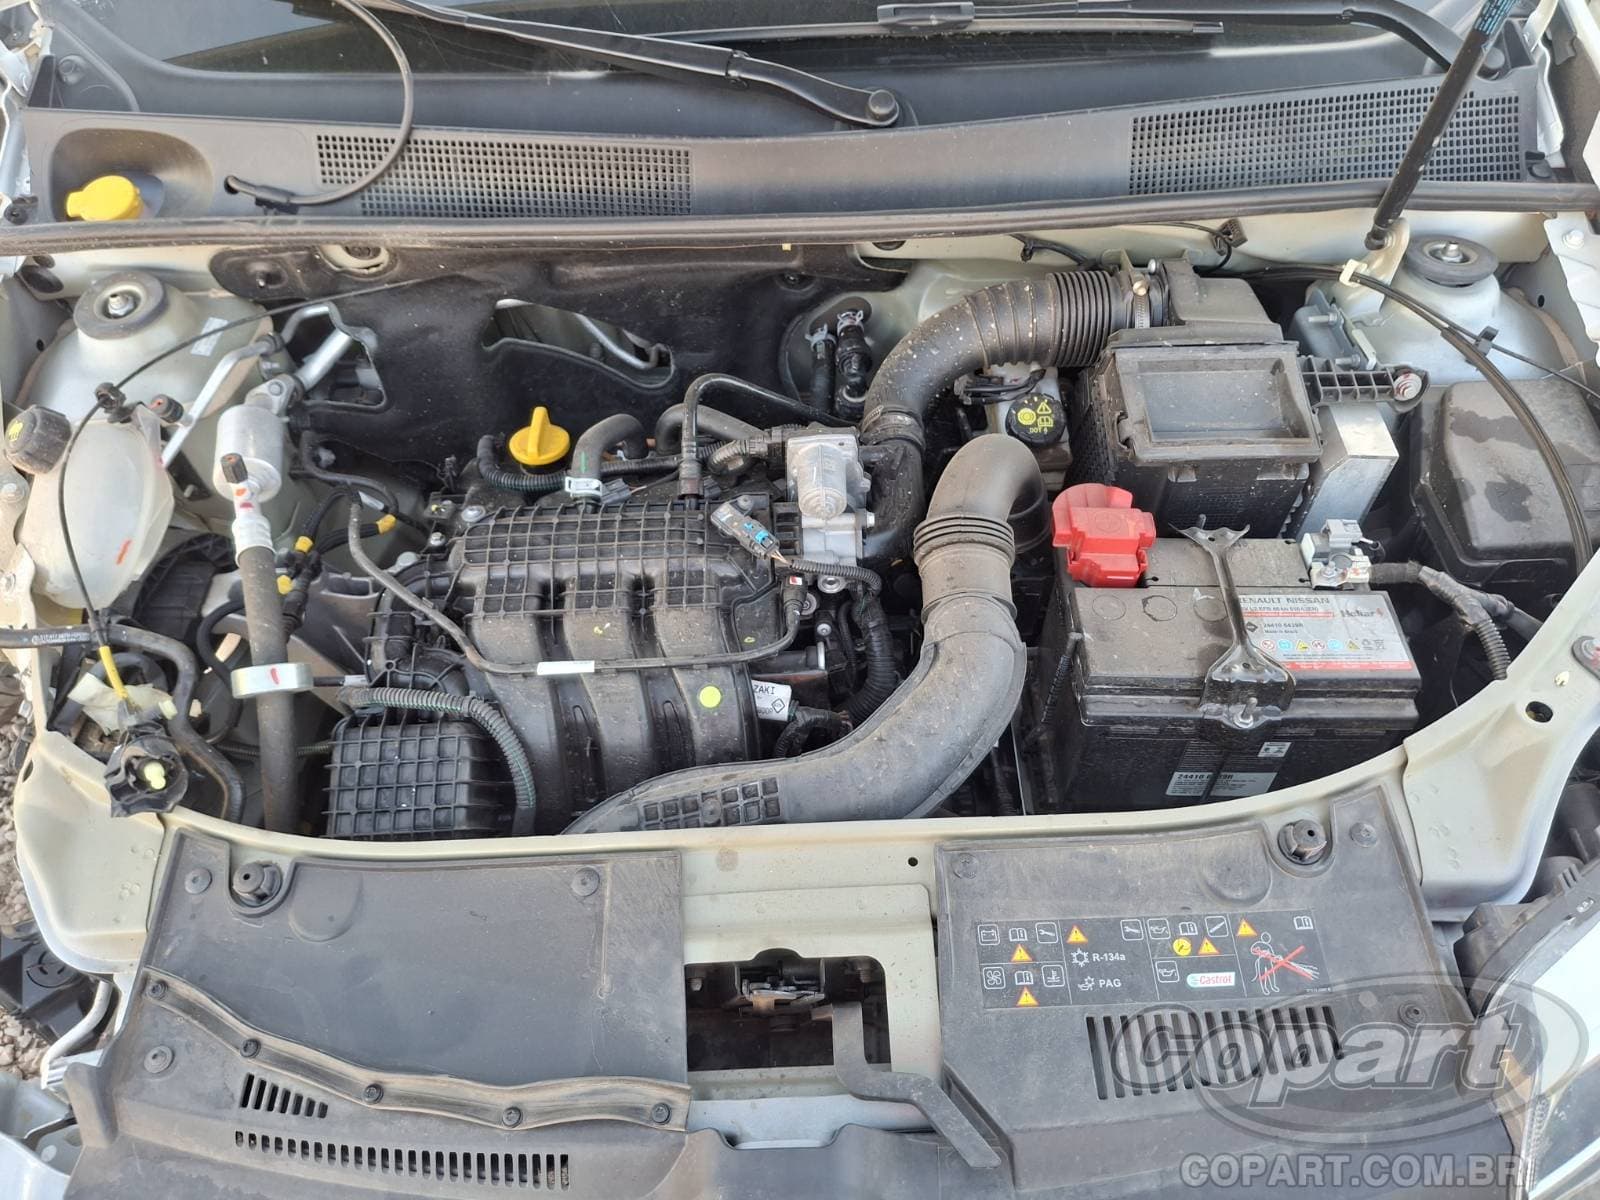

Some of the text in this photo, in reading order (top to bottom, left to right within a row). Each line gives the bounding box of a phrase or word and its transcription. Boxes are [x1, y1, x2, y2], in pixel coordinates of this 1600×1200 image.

[753, 684, 775, 695] ZAKI
[1092, 953, 1126, 962] R-134a
[1099, 978, 1122, 988] PAG
[1199, 974, 1233, 986] Castrol
